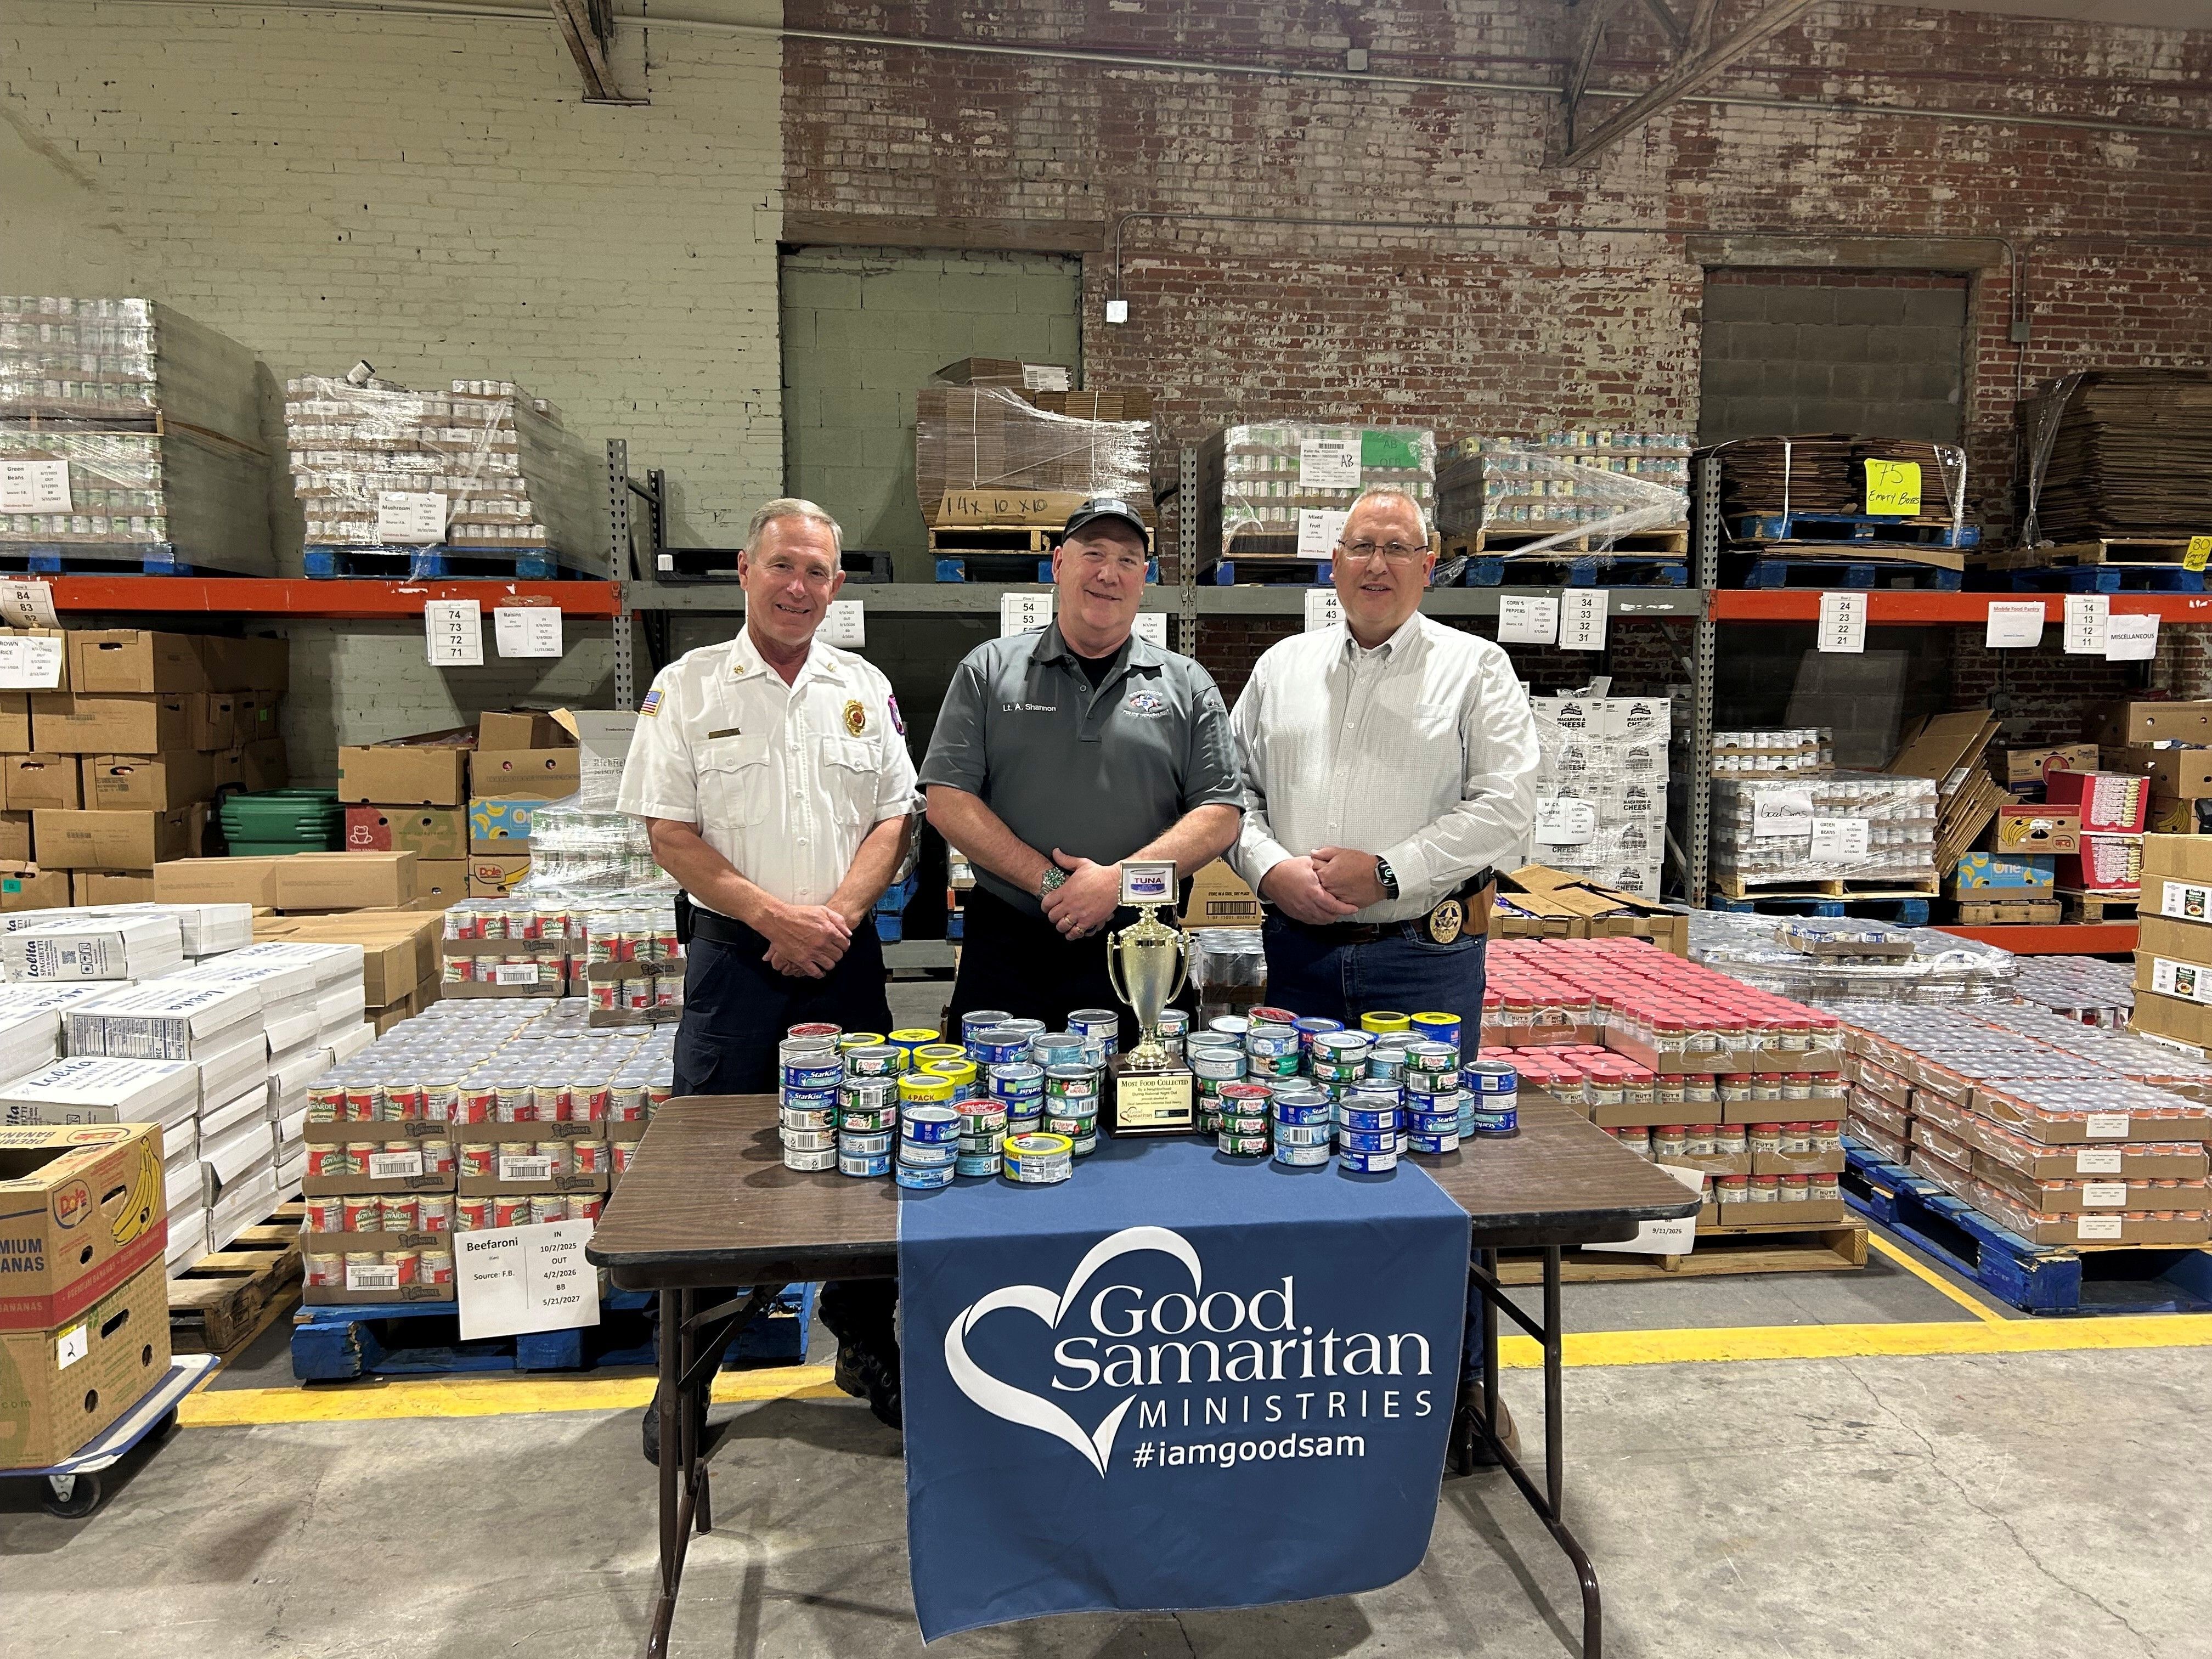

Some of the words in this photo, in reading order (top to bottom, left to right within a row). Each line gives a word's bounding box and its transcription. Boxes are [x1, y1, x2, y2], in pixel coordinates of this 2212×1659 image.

[1383, 440, 1397, 449] AB
[1341, 454, 1354, 467] AB
[1875, 463, 1906, 486] 75
[995, 499, 1009, 514] 10
[2193, 538, 2210, 550] 80
[17, 591, 30, 600] 84
[449, 611, 461, 619] 74
[449, 623, 461, 631] 73
[1579, 622, 1590, 630] 32
[450, 636, 462, 644] 72
[1578, 634, 1588, 642] 31
[451, 648, 462, 657] 71
[1025, 704, 1057, 712] Shannon
[480, 867, 501, 876] Dole
[1993, 861, 2022, 874] One
[26, 940, 39, 977] Lolita
[37, 940, 47, 977] SPAGHETTI
[29, 1061, 98, 1087] Lolita
[810, 1069, 837, 1078] StarKist
[75, 1132, 121, 1141] Dole
[59, 1188, 88, 1215] Dole
[467, 1237, 518, 1251] Beefaroni
[540, 1243, 577, 1252] 10/2/2025
[473, 1272, 501, 1280] Source:
[543, 1269, 577, 1279] 4/2/2026
[543, 1295, 580, 1306] 5/21/2027
[1091, 1276, 1296, 1337] Good
[1051, 1326, 1433, 1391] Samaritan
[1139, 1390, 1432, 1429] MINISTRIES
[1133, 1434, 1365, 1469] #iamgoodsam
